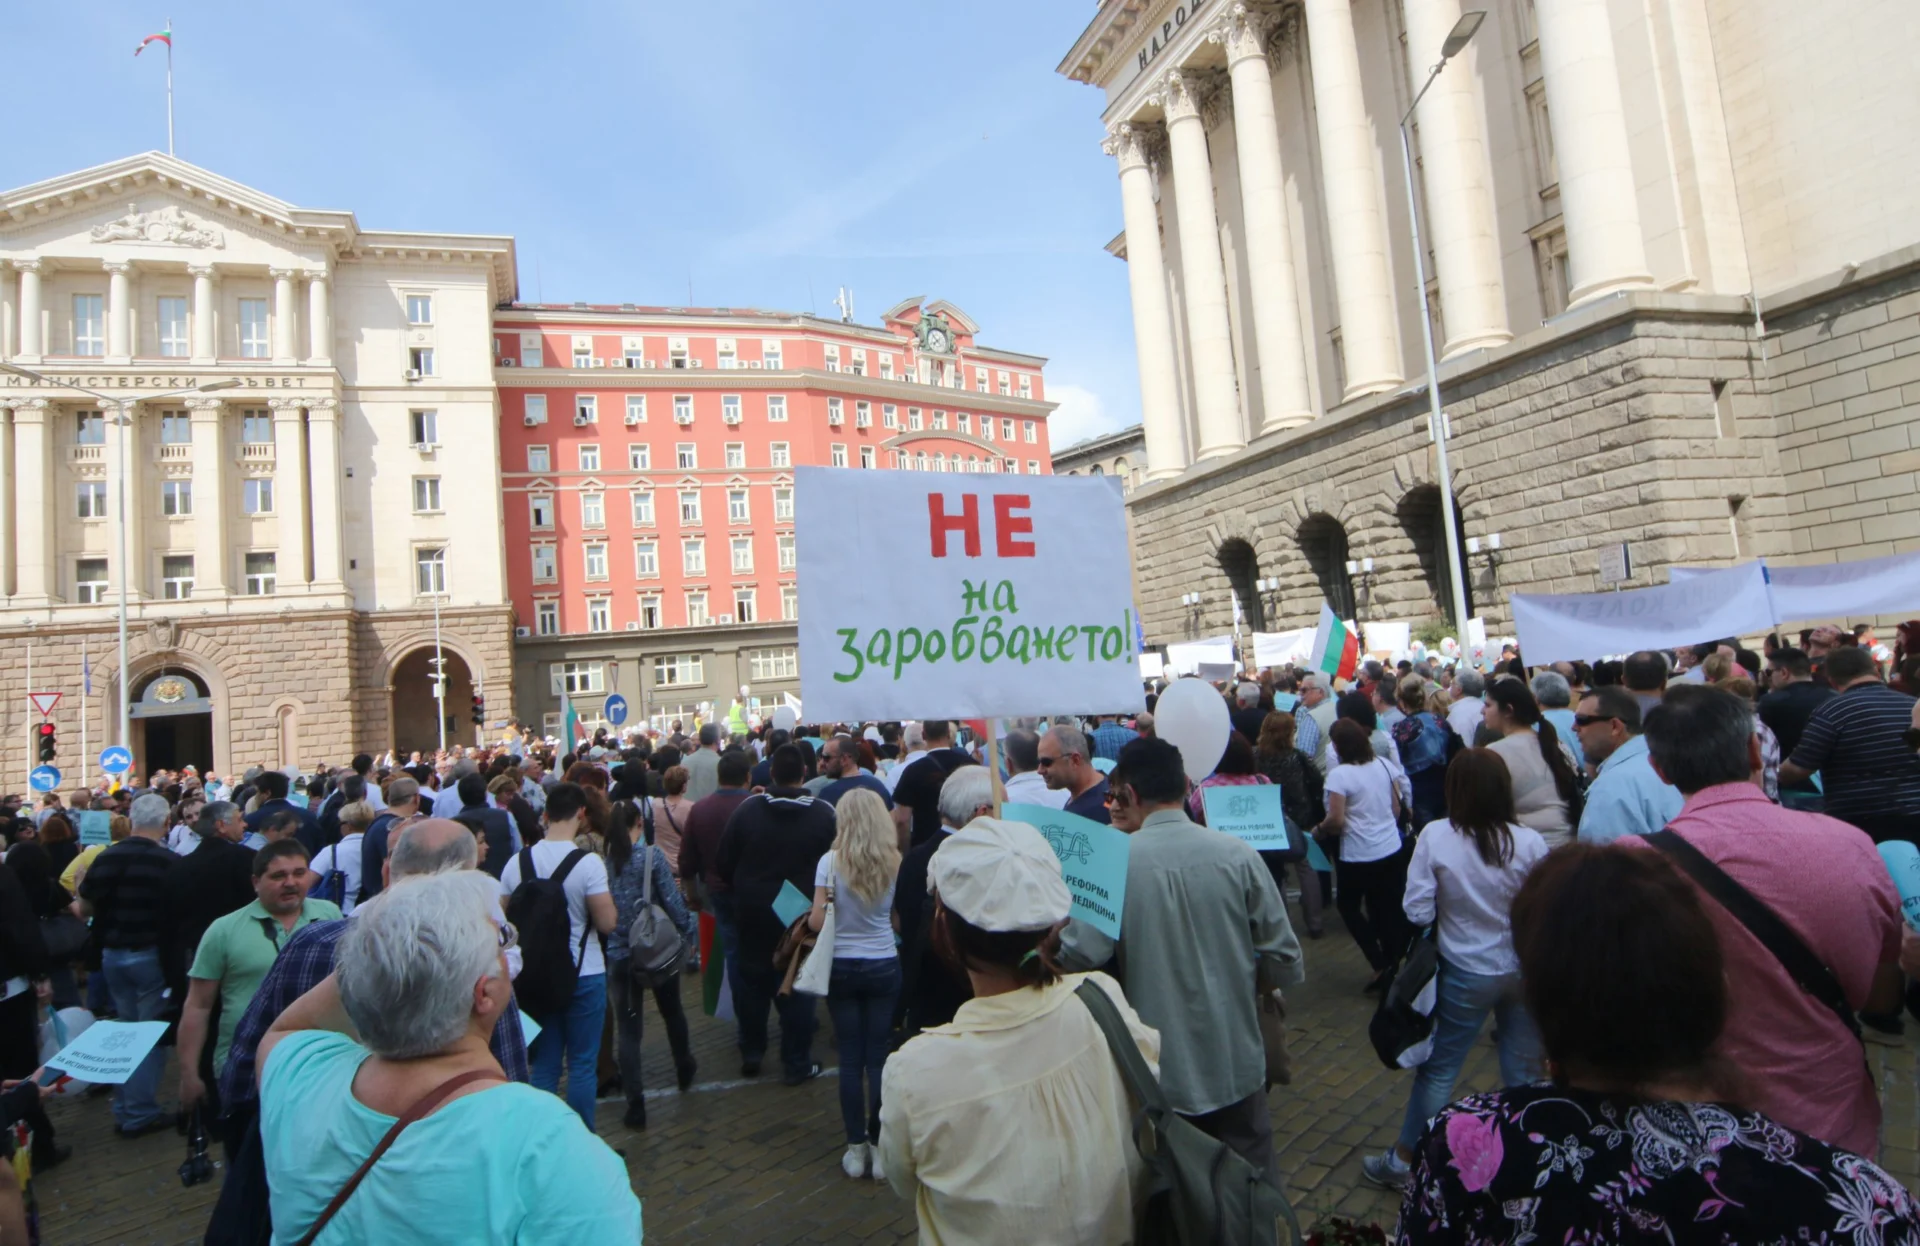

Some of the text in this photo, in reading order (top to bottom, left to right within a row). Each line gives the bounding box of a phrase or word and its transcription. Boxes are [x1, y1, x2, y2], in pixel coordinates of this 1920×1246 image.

[6, 376, 306, 388] МИНИСТЕРСКИ ЪВЕТ
[927, 492, 1036, 558] НЕ
[961, 579, 1019, 614] на
[1065, 874, 1109, 900] РЕФОРМА
[1071, 893, 1116, 923] МЕДИЦИНА
